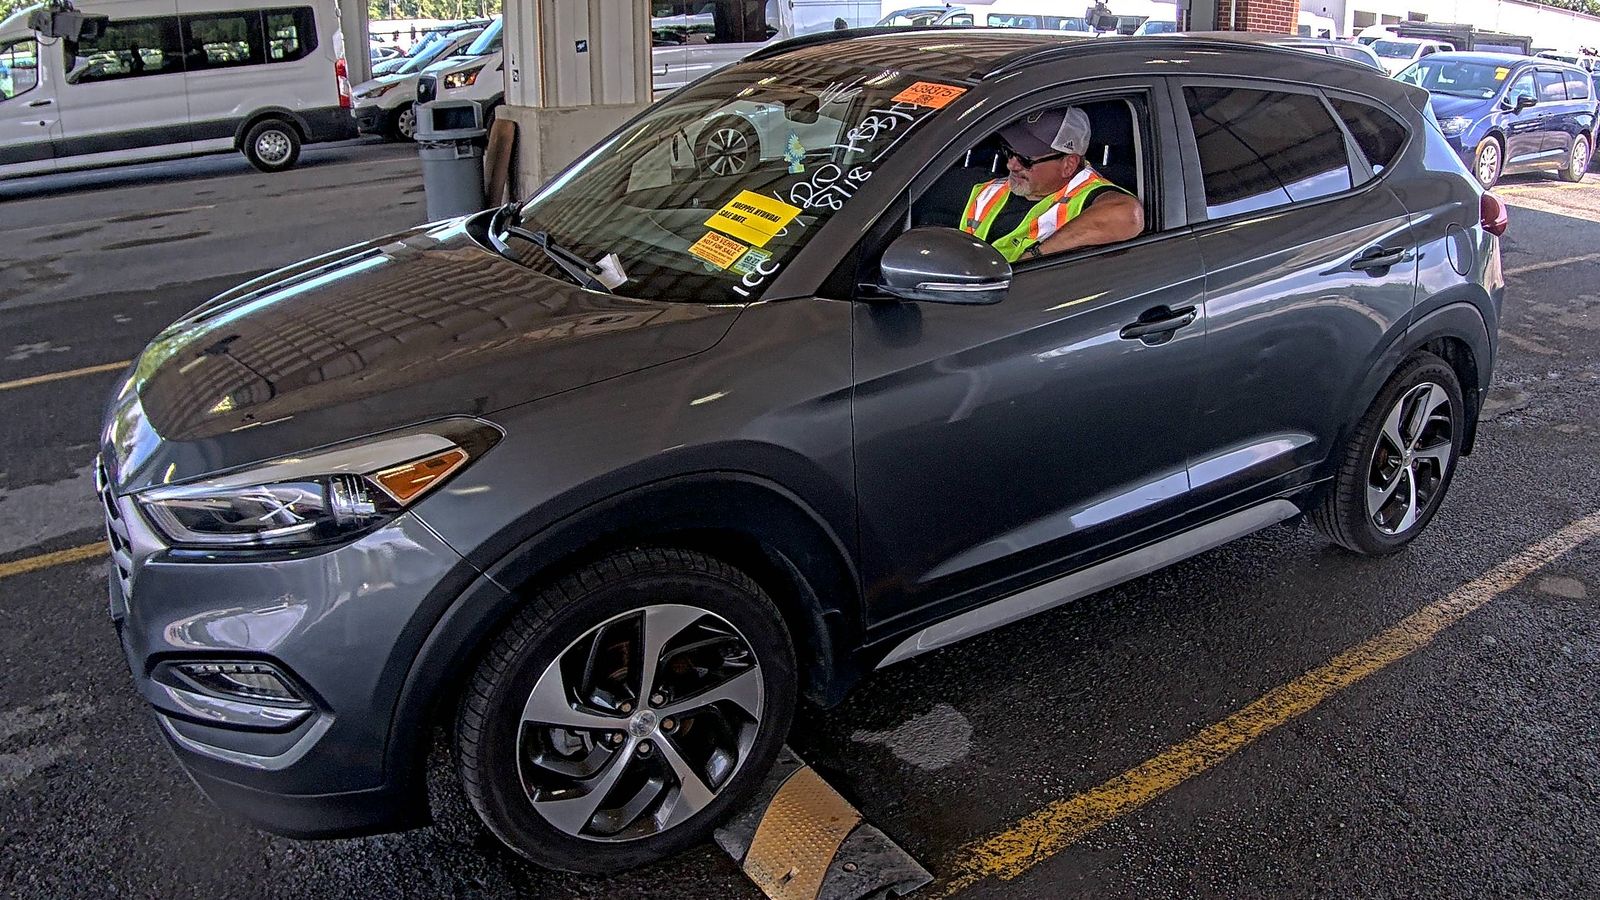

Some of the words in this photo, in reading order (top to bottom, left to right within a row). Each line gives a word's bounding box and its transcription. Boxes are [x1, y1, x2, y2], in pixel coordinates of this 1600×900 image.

[718, 210, 734, 219] SALE
[730, 213, 748, 223] DATE
[753, 208, 782, 223] HYUNDAI
[703, 239, 714, 248] NOT
[713, 242, 726, 252] FOR
[723, 246, 738, 257] SALE
[707, 232, 721, 242] THIS
[719, 238, 744, 253] VEHICLE
